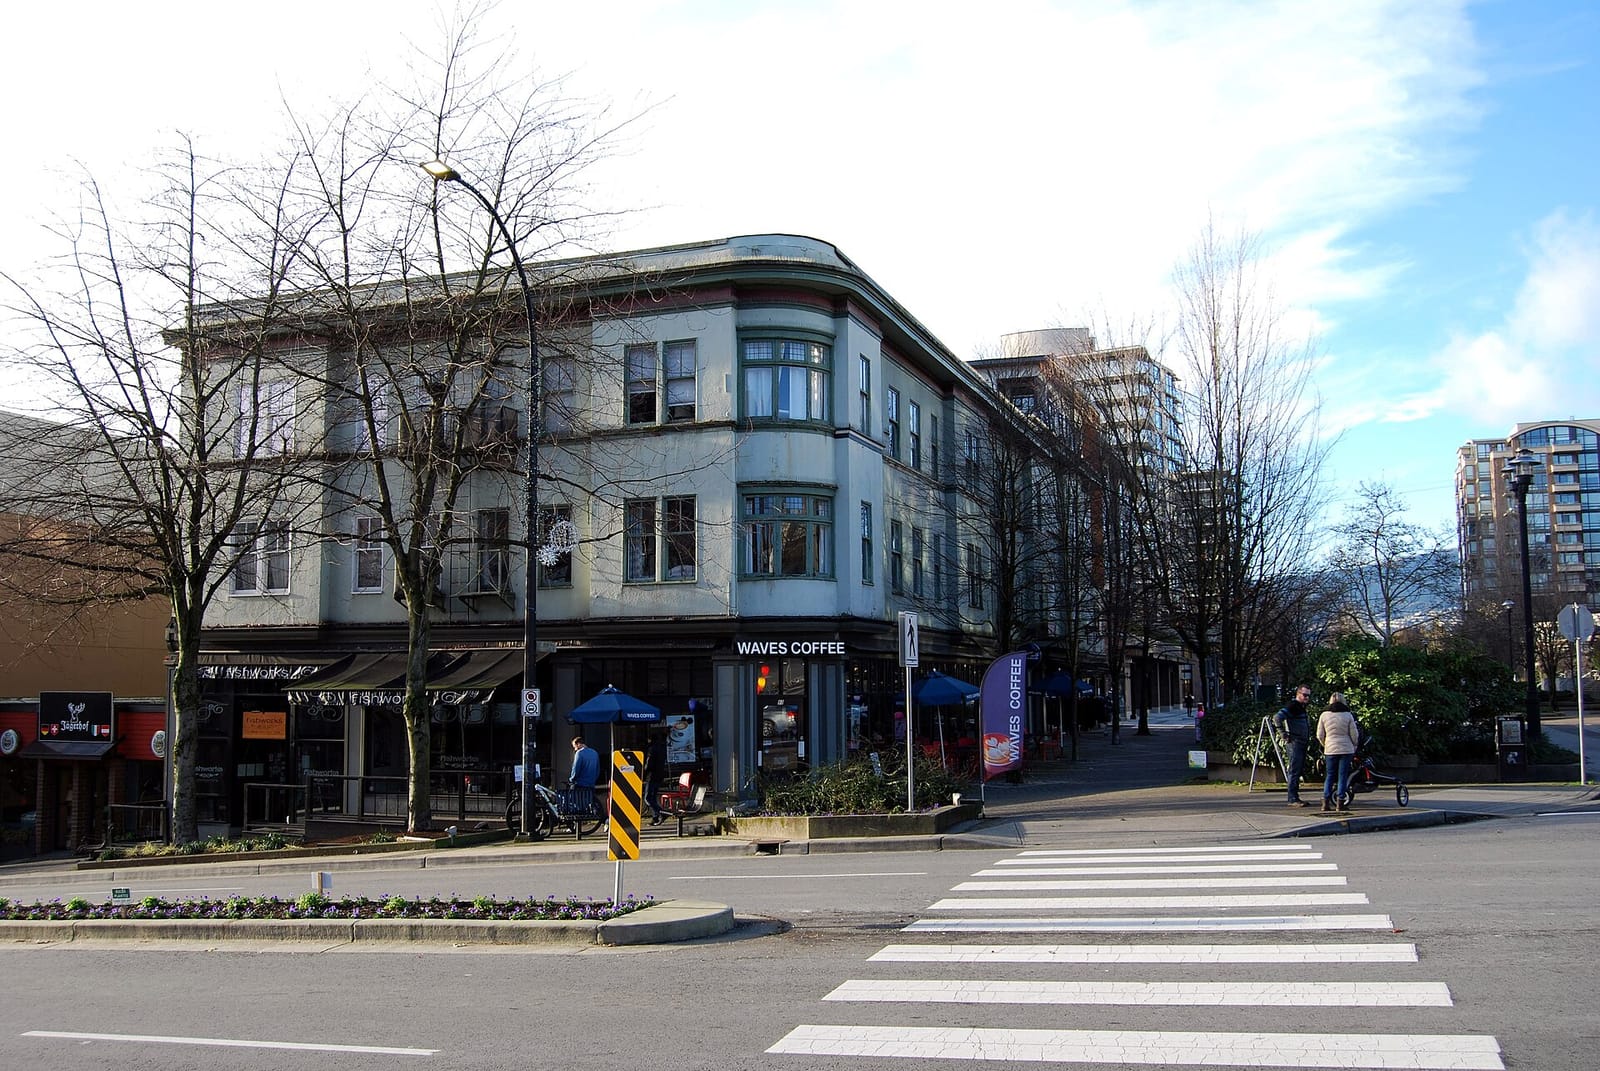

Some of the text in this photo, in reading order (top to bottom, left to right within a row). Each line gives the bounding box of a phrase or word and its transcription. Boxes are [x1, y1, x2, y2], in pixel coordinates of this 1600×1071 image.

[737, 642, 845, 655] WAVES COFFEE
[1009, 658, 1022, 762] WAVES COFFEE
